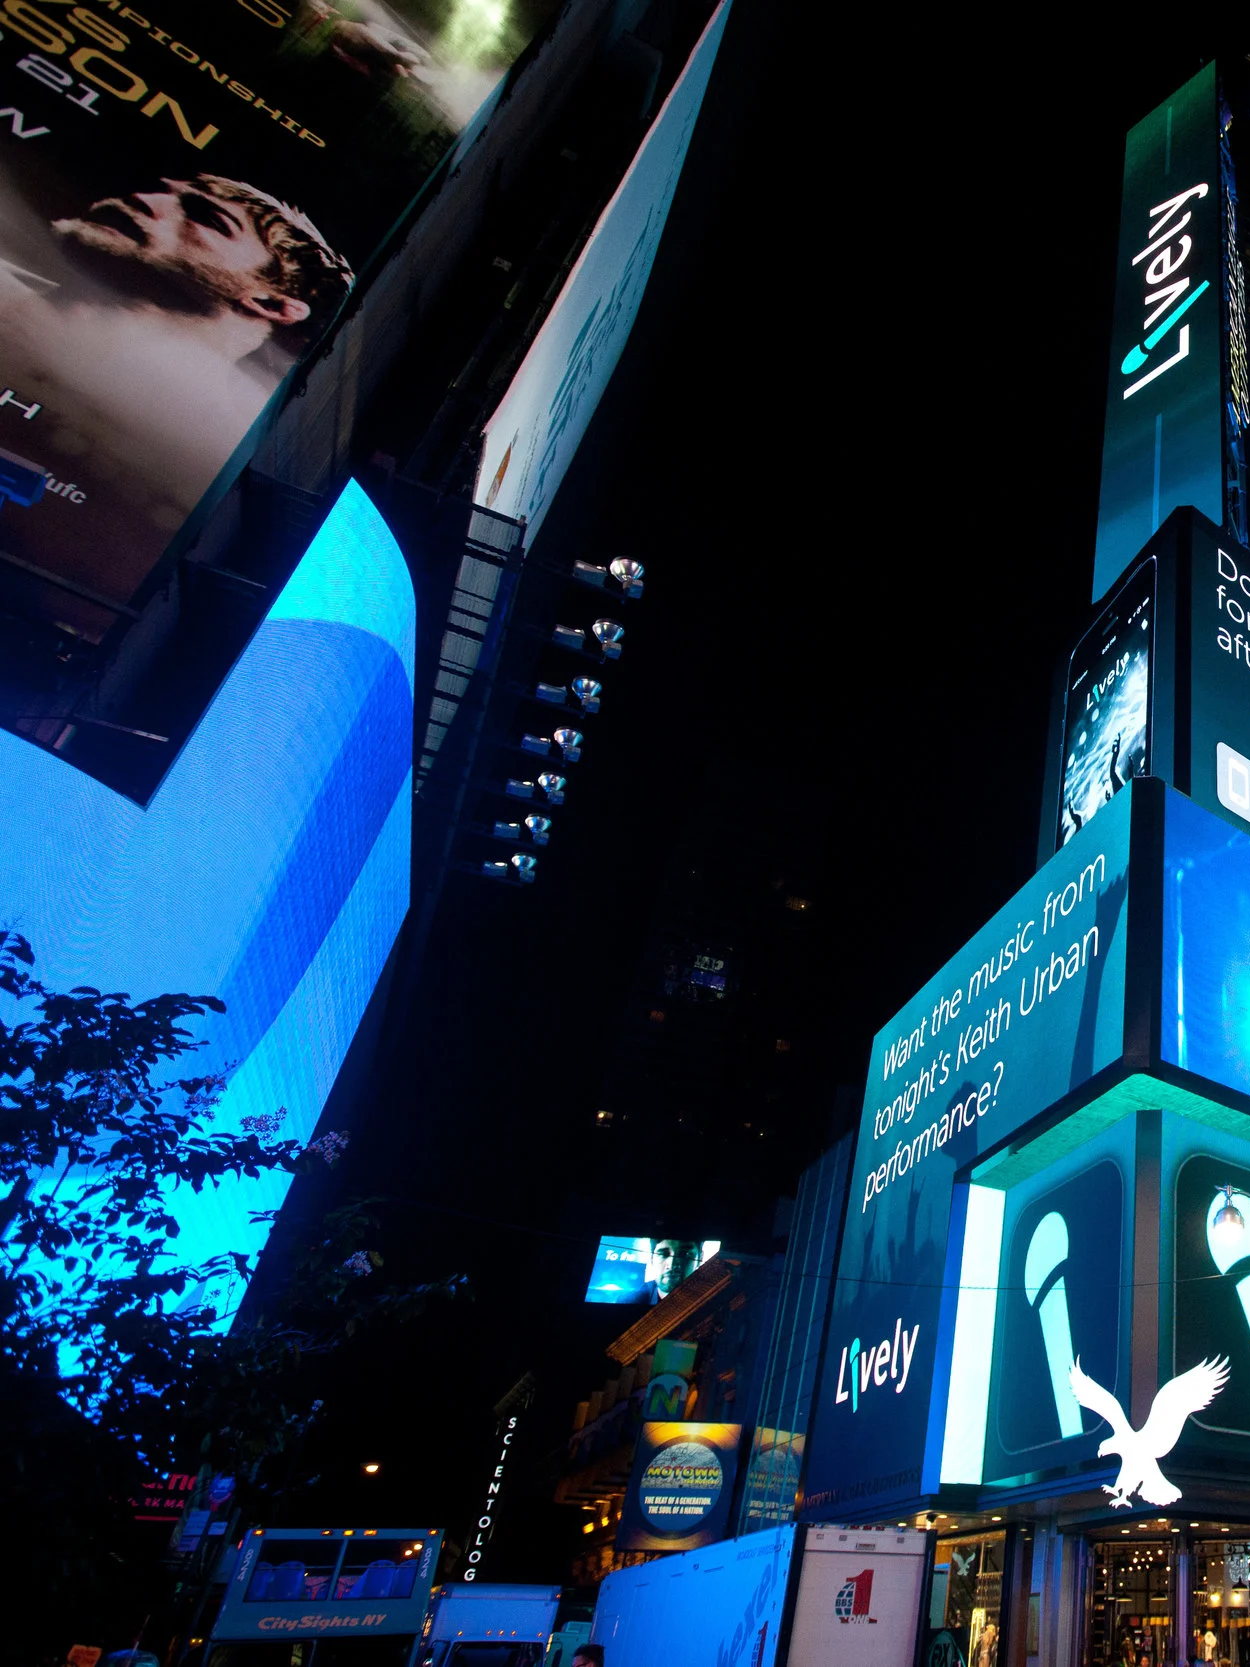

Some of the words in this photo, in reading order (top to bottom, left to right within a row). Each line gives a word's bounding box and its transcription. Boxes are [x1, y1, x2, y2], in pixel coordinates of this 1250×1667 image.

[16, 53, 99, 116] 21
[882, 1015, 928, 1083] Want
[930, 986, 963, 1038] the
[967, 919, 1036, 1006] music
[1040, 852, 1106, 935] from
[872, 1051, 950, 1142] tonight's
[955, 997, 1012, 1072] Keith
[1019, 925, 1100, 1017] Urban
[862, 1060, 1005, 1215] performance?
[834, 1317, 920, 1414] Lively
[463, 1416, 517, 1582] SCIENTOLOG
[647, 1465, 720, 1481] MOTOWN
[257, 1613, 361, 1632] CitySights
[361, 1613, 388, 1627] NY
